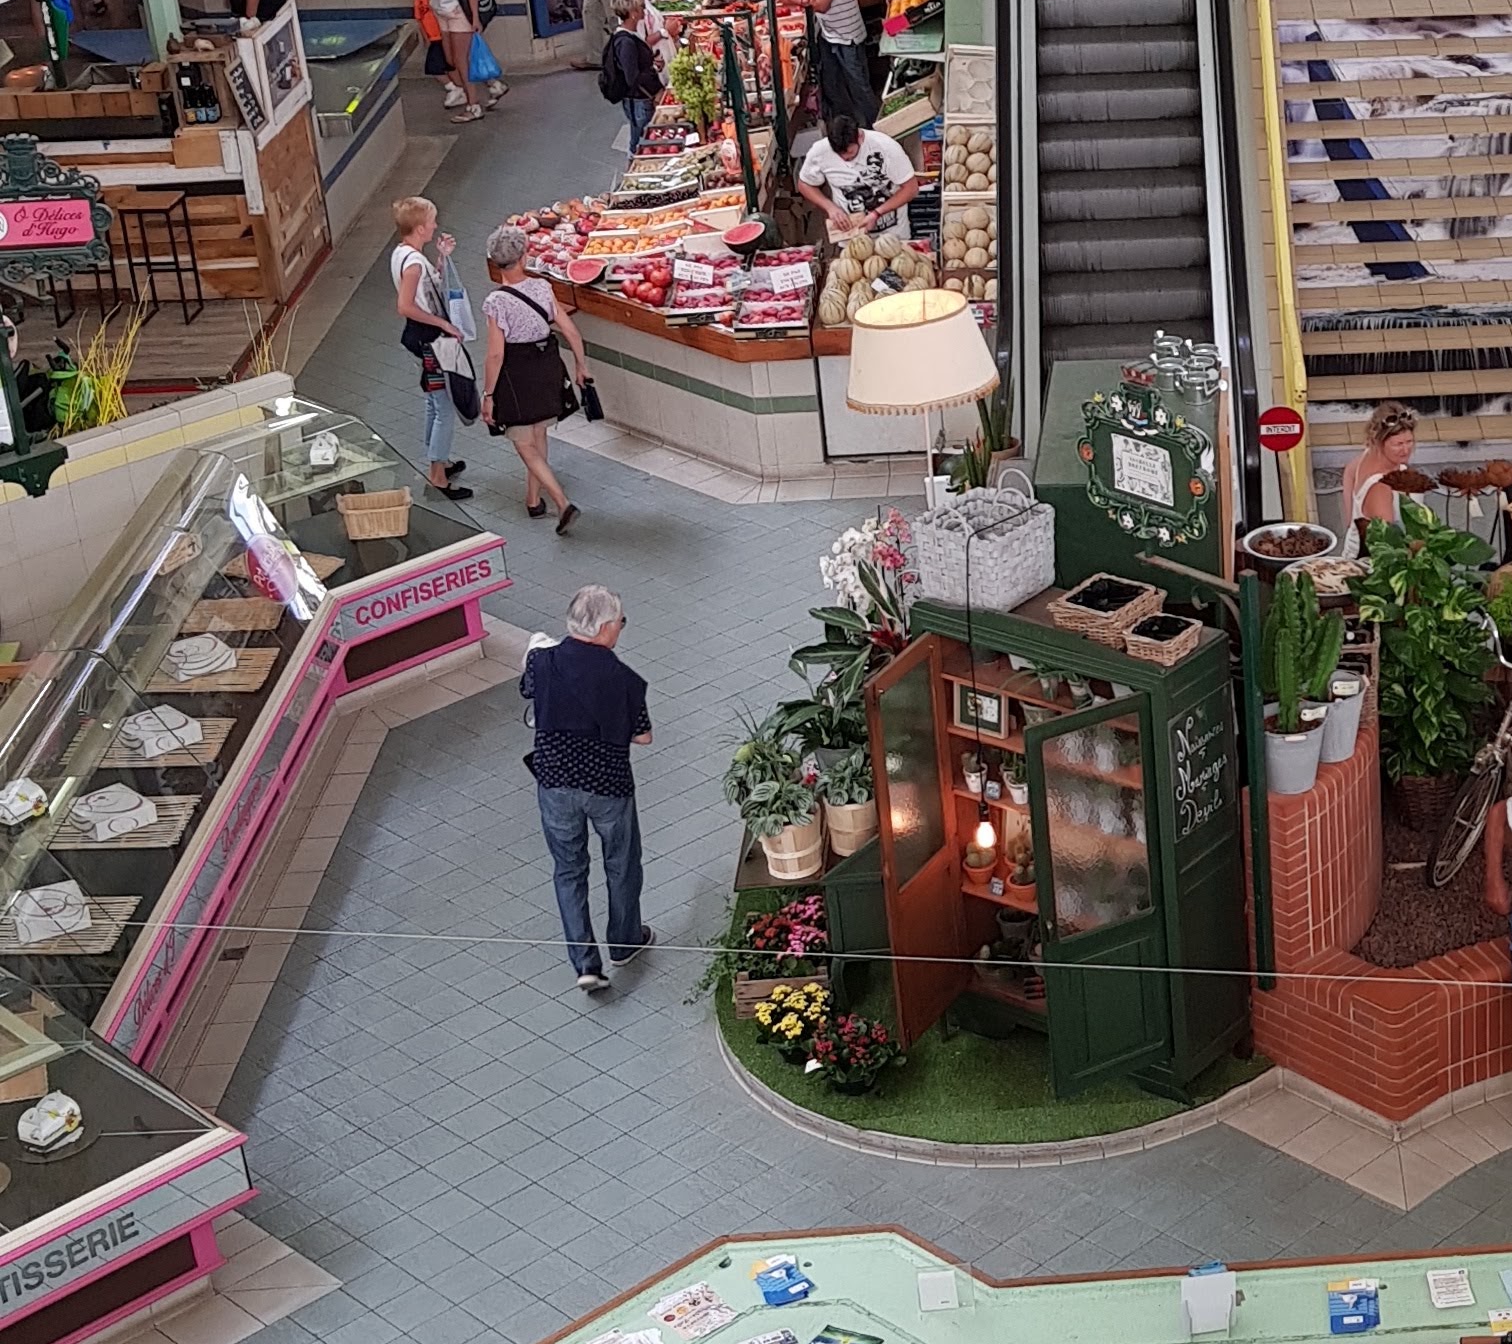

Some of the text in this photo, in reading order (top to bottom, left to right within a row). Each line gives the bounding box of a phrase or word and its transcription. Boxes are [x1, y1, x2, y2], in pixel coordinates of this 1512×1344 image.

[33, 207, 84, 223] Délices
[22, 222, 80, 240] d'Hugo
[1265, 425, 1297, 434] INTERDIT
[355, 559, 492, 626] CONFISERIES
[0, 1211, 140, 1304] TISSERIE
